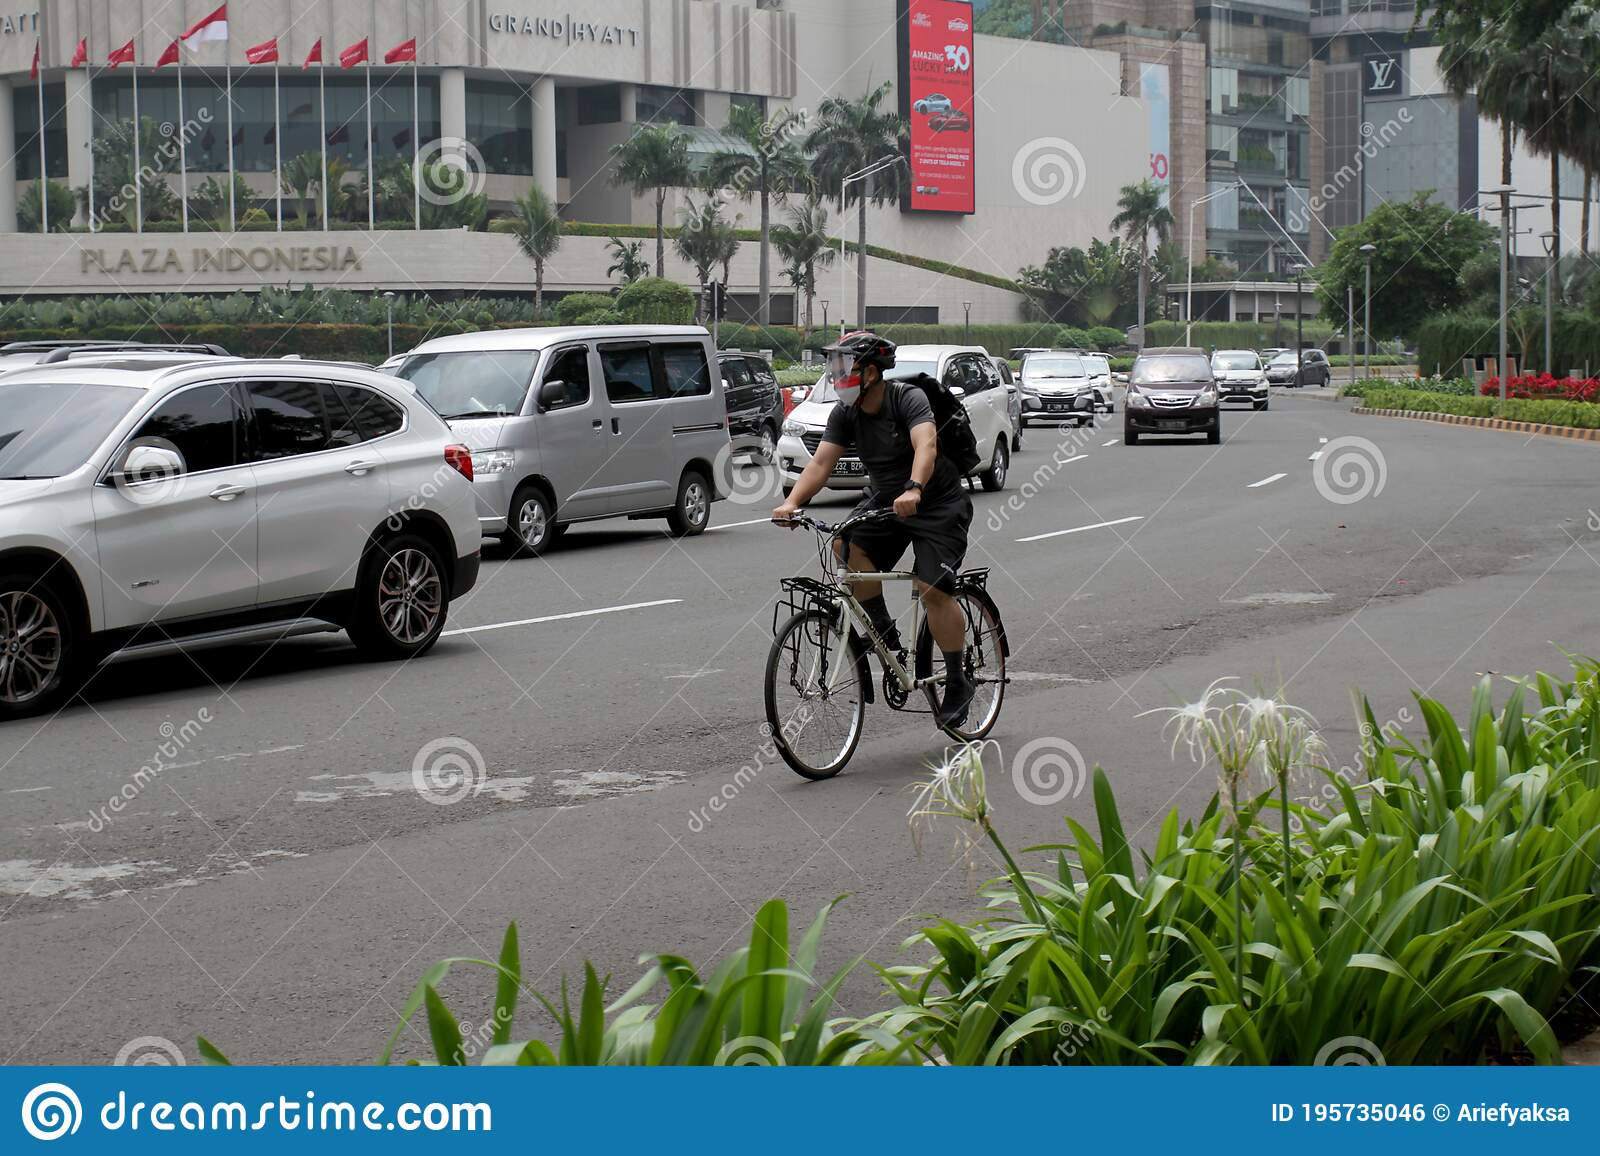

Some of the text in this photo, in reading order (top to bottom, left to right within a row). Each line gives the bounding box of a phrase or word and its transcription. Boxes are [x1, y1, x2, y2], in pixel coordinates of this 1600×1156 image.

[489, 14, 641, 47] GRAND HYATT
[912, 49, 944, 61] AMAZING
[943, 45, 970, 71] 30
[80, 246, 363, 273] PLAZA INDONESIA
